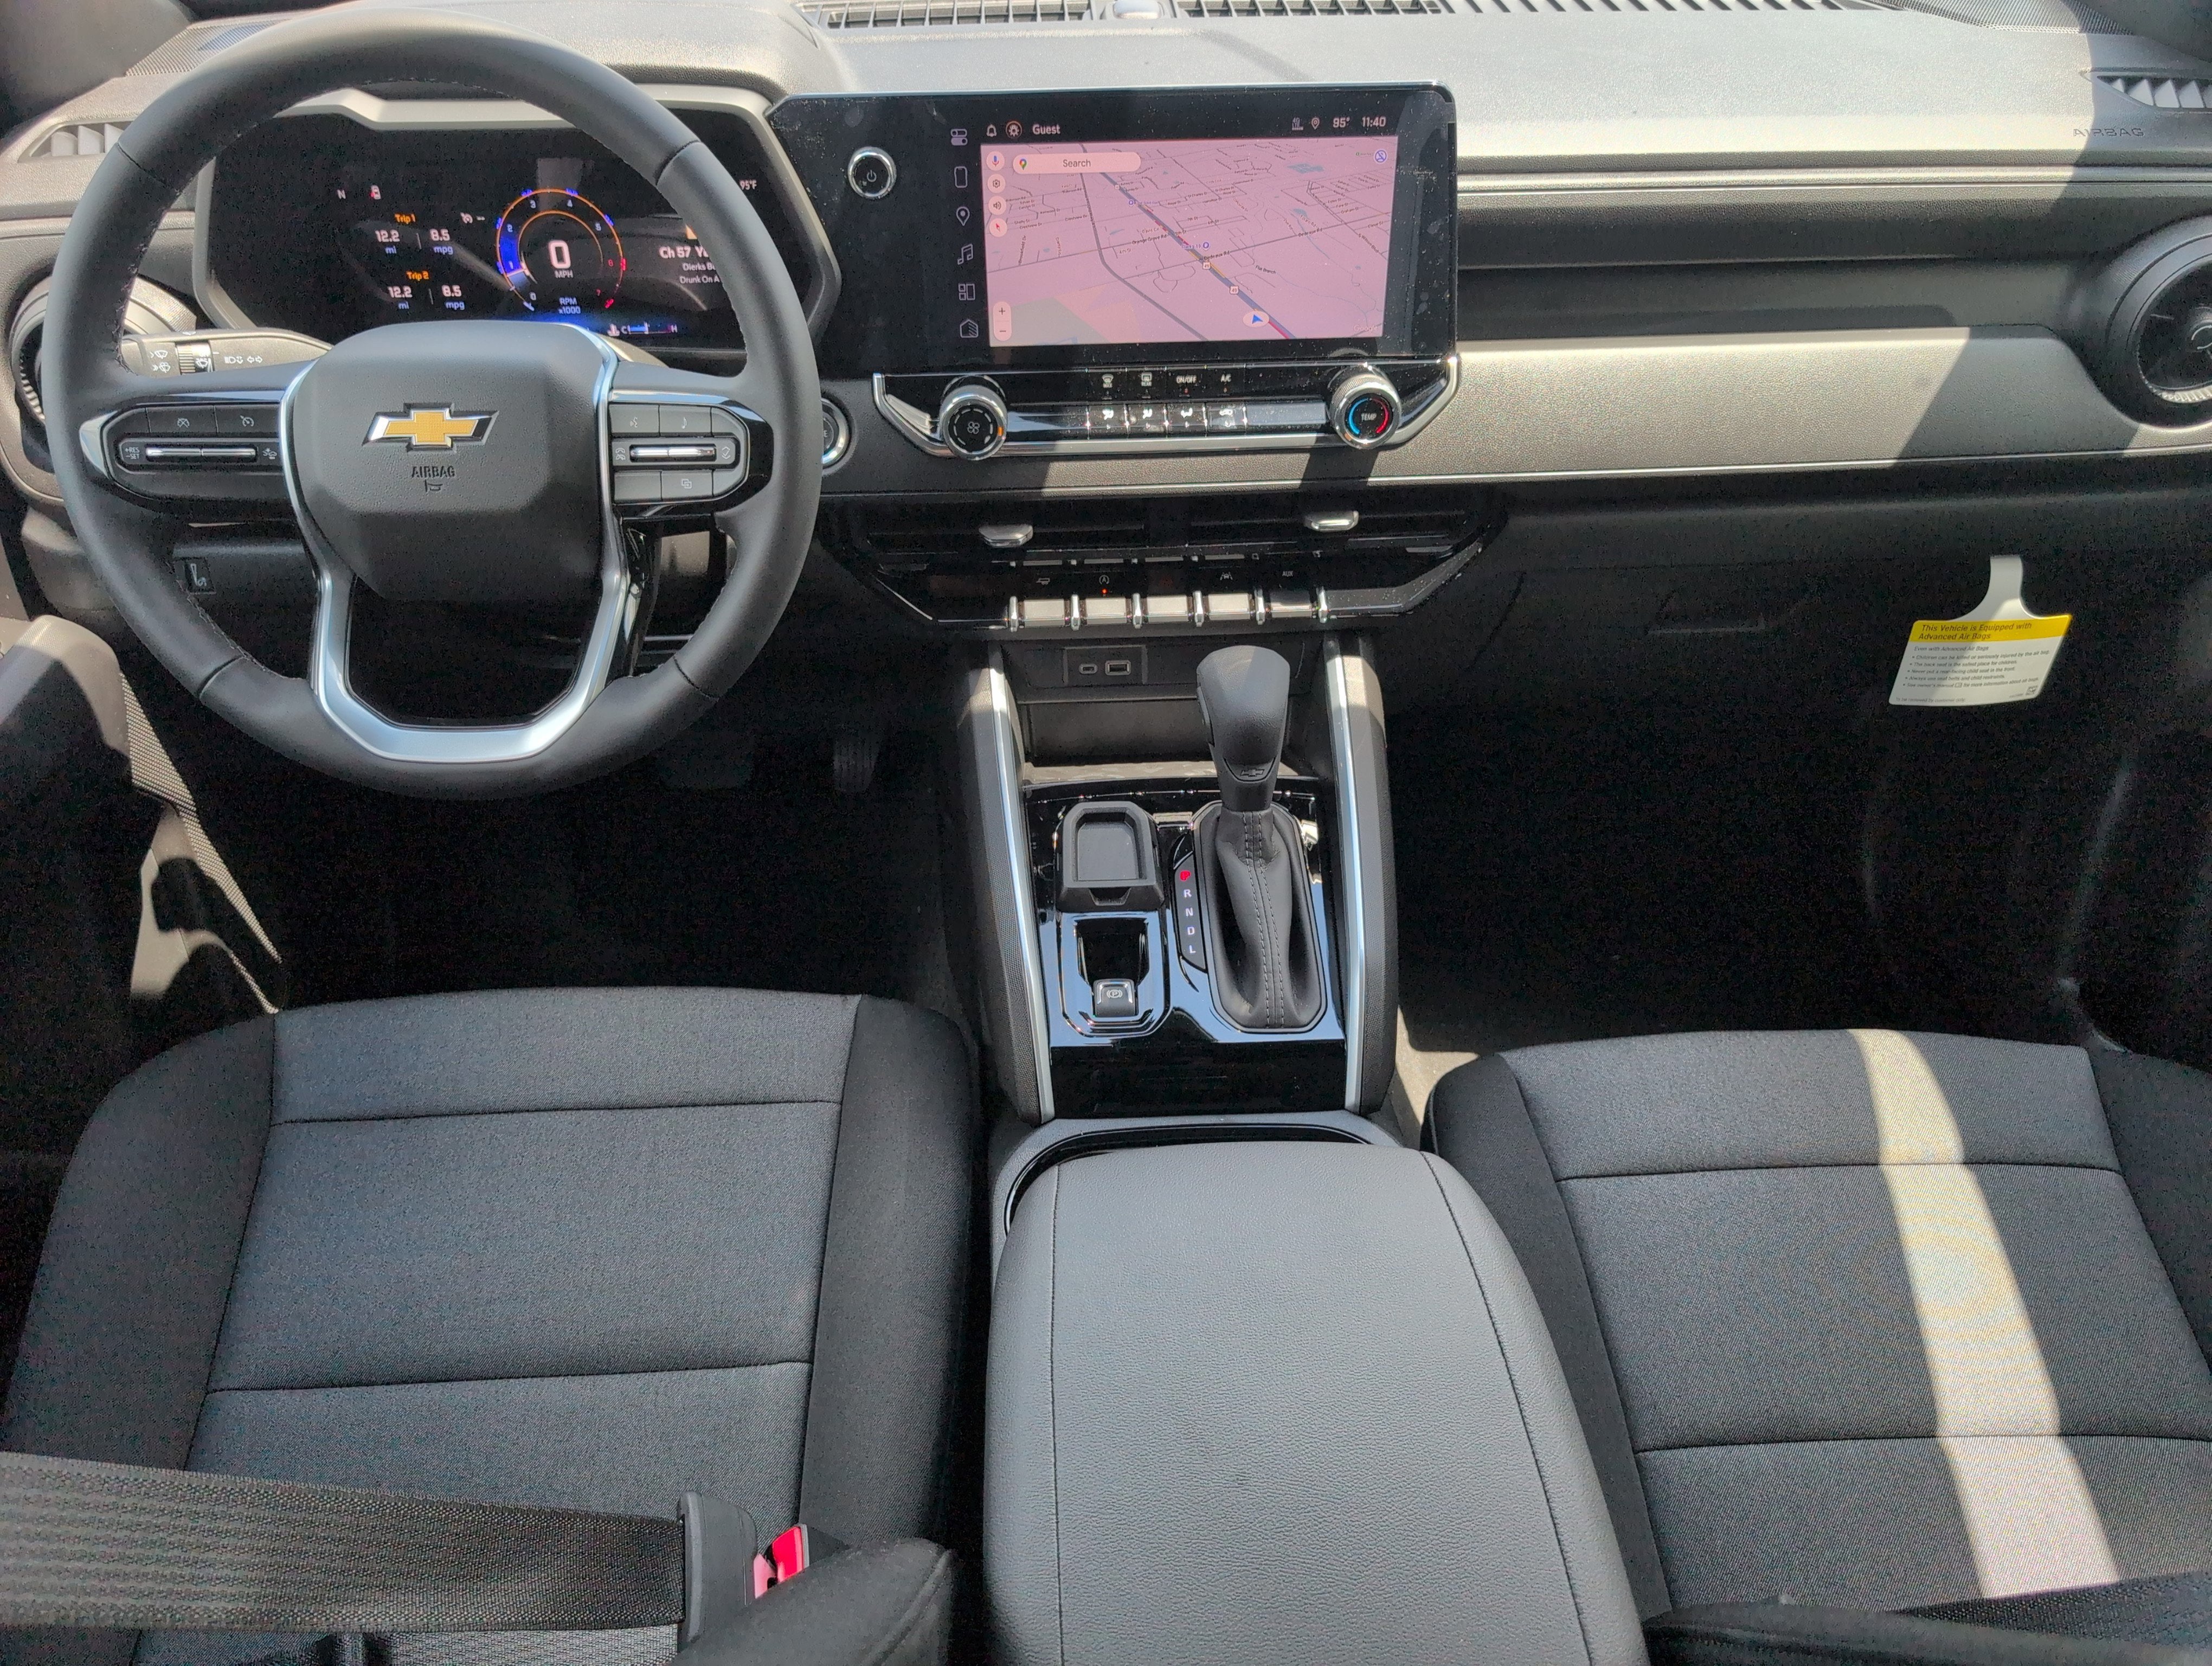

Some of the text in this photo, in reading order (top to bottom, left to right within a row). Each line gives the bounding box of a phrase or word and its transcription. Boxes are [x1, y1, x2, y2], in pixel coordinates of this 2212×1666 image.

[1333, 116, 1386, 128] 95° 11:40
[1032, 124, 1060, 135] Guest
[2073, 127, 2145, 137] AIRBAG
[1063, 159, 1091, 168] Search
[740, 180, 757, 190] 95°F
[337, 189, 346, 199] N
[530, 201, 536, 209] 3
[567, 200, 573, 208] 4
[394, 214, 416, 225] Trip 1
[375, 228, 450, 242] 12.2 8.5
[385, 246, 453, 255] mi mpg
[548, 240, 571, 269] 0
[659, 245, 709, 258] Ch 57 Y
[407, 271, 429, 280] Trip 2
[679, 275, 701, 284] Drunk
[714, 274, 720, 283] A
[387, 285, 461, 298] 12.2 8.5
[398, 301, 465, 310] mi mpg
[559, 297, 577, 305] RPM
[558, 305, 581, 314] x1000
[1176, 375, 1197, 384] ON/OFF
[1220, 373, 1232, 383] A/C
[1360, 413, 1378, 421] TEMP
[411, 465, 455, 478] AIRBAG
[1979, 623, 2015, 632] Equipped
[1972, 632, 1991, 640] Bags
[1184, 889, 1192, 898] R
[1185, 907, 1193, 917] N
[1187, 926, 1195, 935] D
[1189, 945, 1196, 954] L
